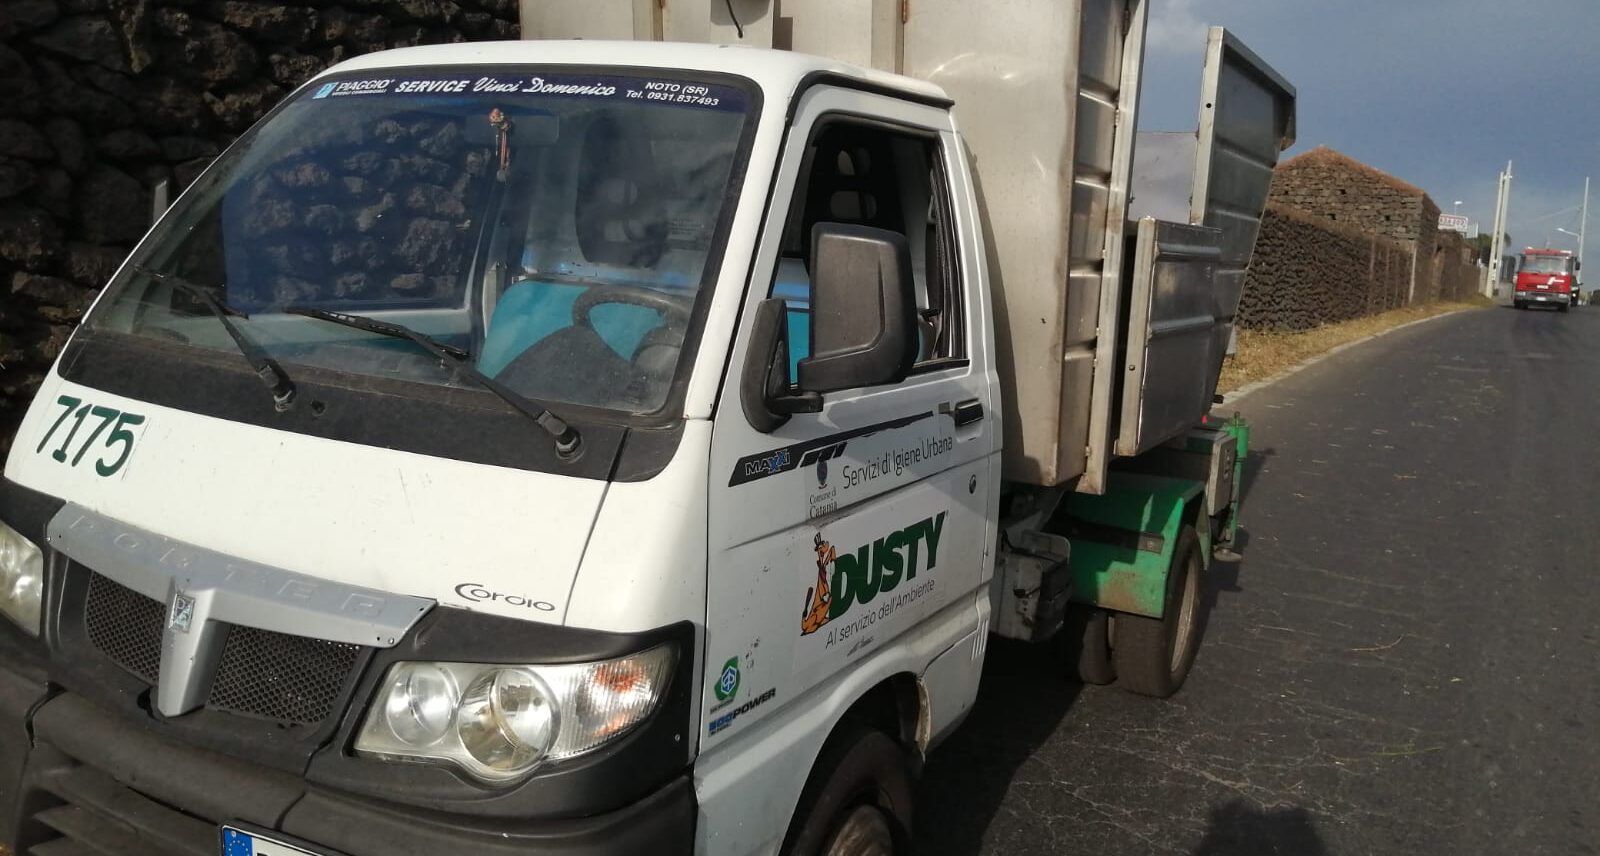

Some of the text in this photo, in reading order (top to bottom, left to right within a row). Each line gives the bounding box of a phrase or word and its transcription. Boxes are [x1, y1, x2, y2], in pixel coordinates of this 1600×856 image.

[336, 76, 616, 96] PIAGGIO SERVICE Vinci Domenico
[626, 89, 720, 106] Tel. 0931.837493
[645, 82, 709, 96] NOTO (SR)
[36, 394, 145, 477] 7175
[842, 436, 952, 489] Servizi di Igiene Urbana
[829, 510, 946, 620] DUSTY
[825, 627, 838, 650] Al
[839, 609, 877, 642] servizio
[878, 578, 935, 620] dell'Ambiente
